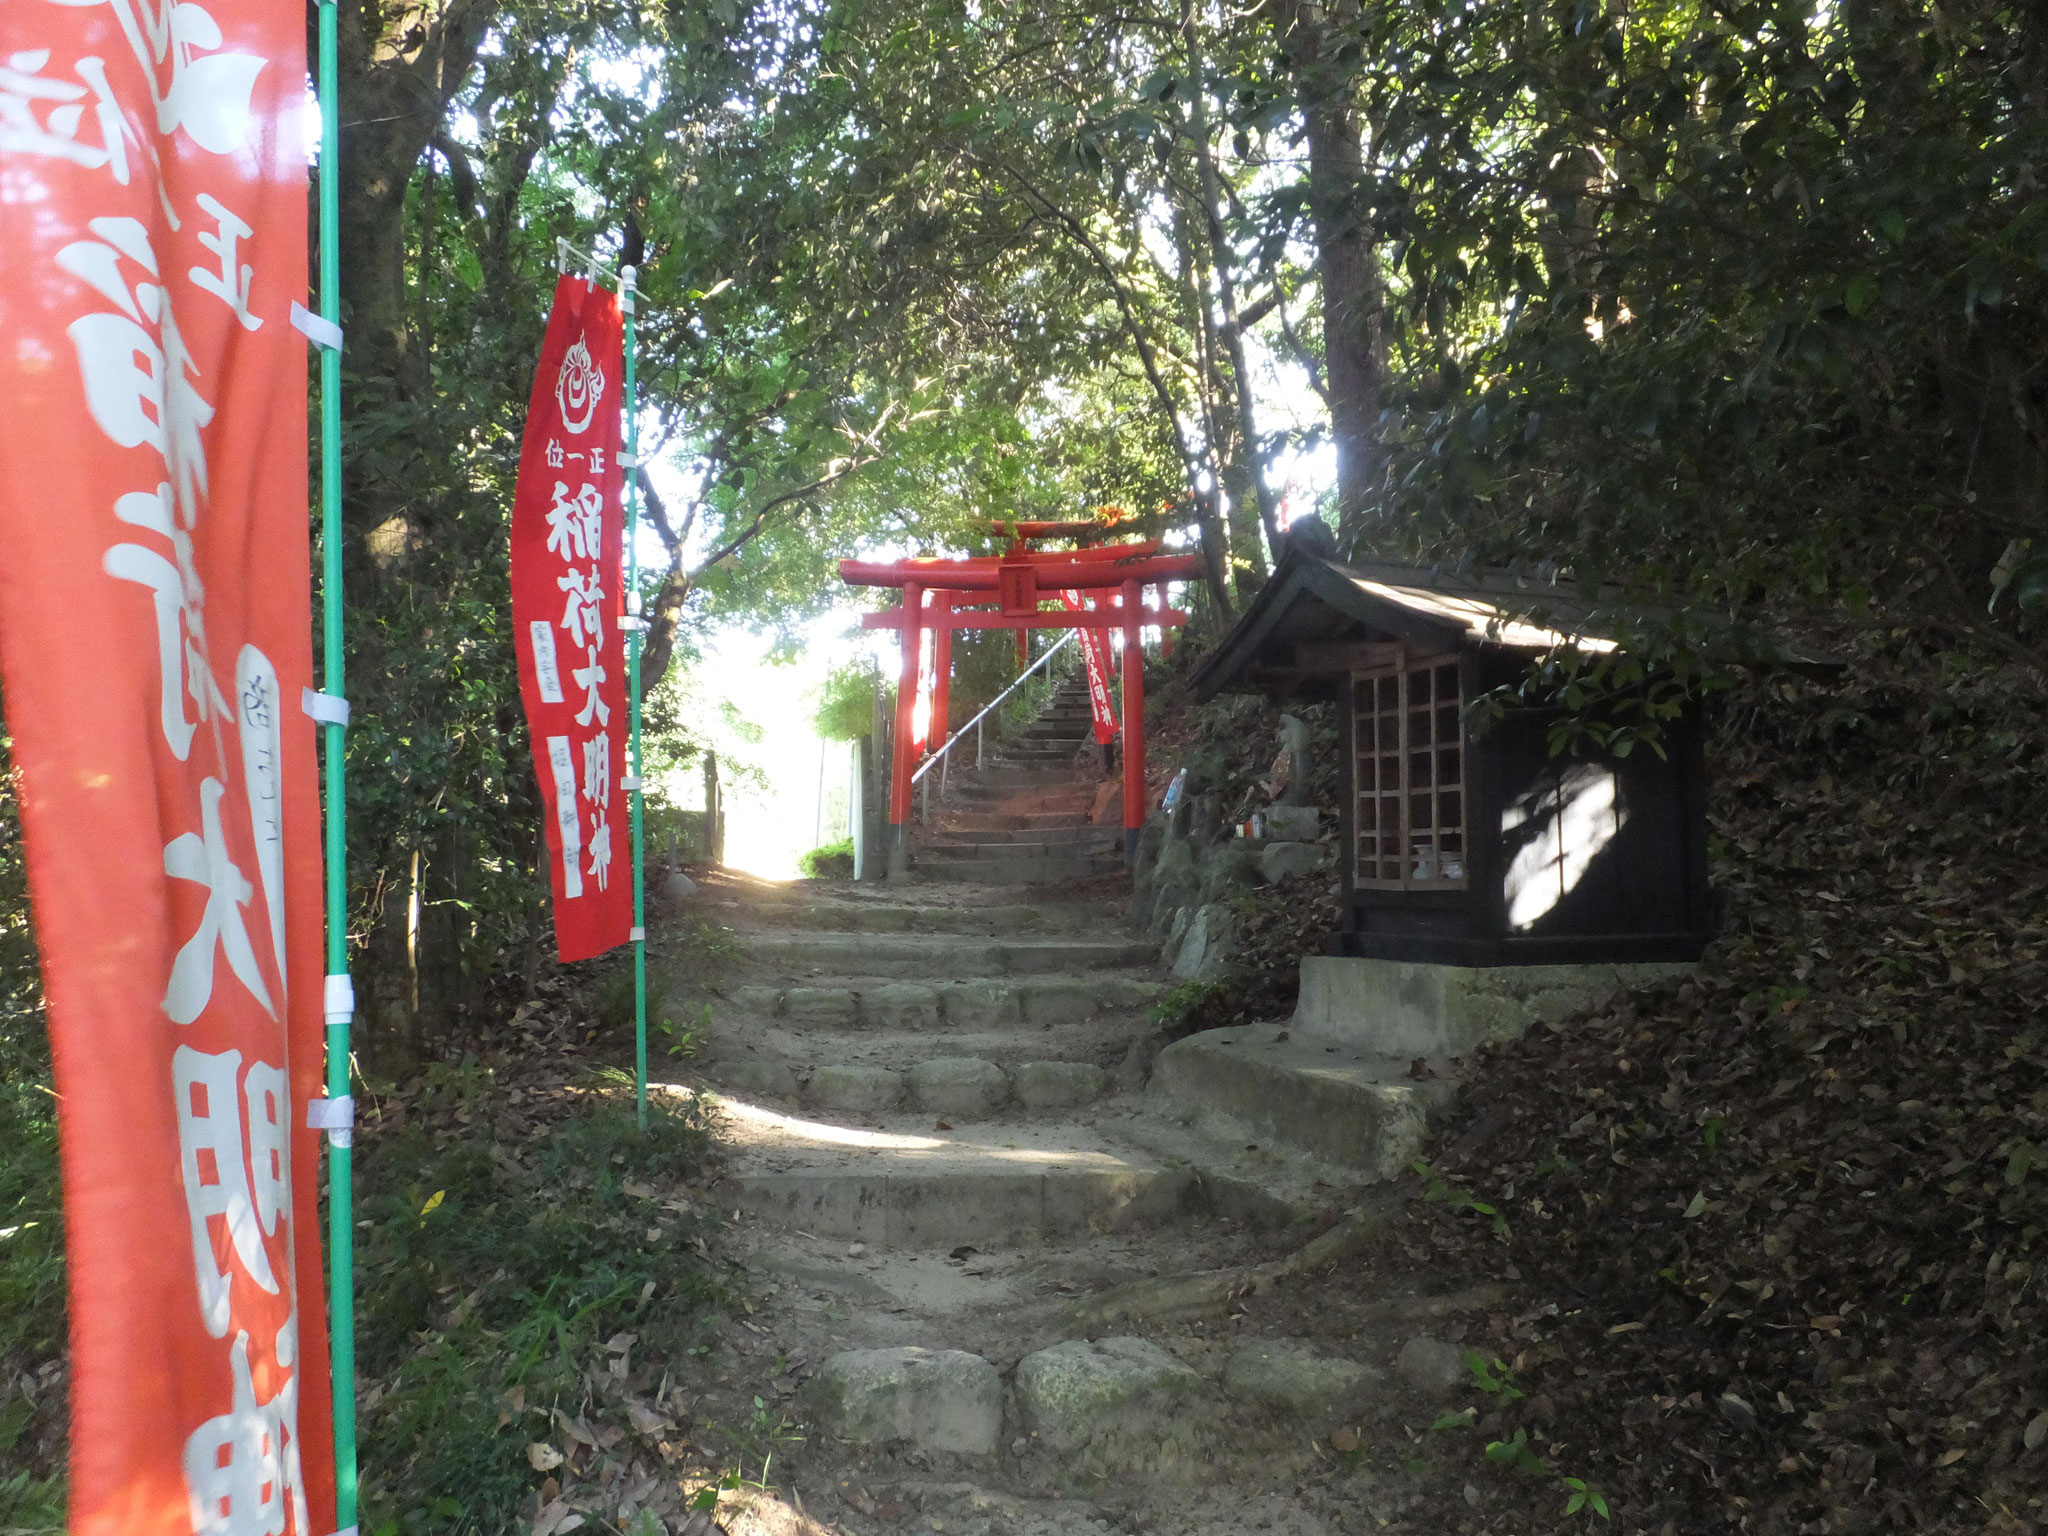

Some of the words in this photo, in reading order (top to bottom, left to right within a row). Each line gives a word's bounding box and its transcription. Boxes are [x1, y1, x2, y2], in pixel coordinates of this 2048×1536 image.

[545, 481, 611, 892] 稲荷大明神
